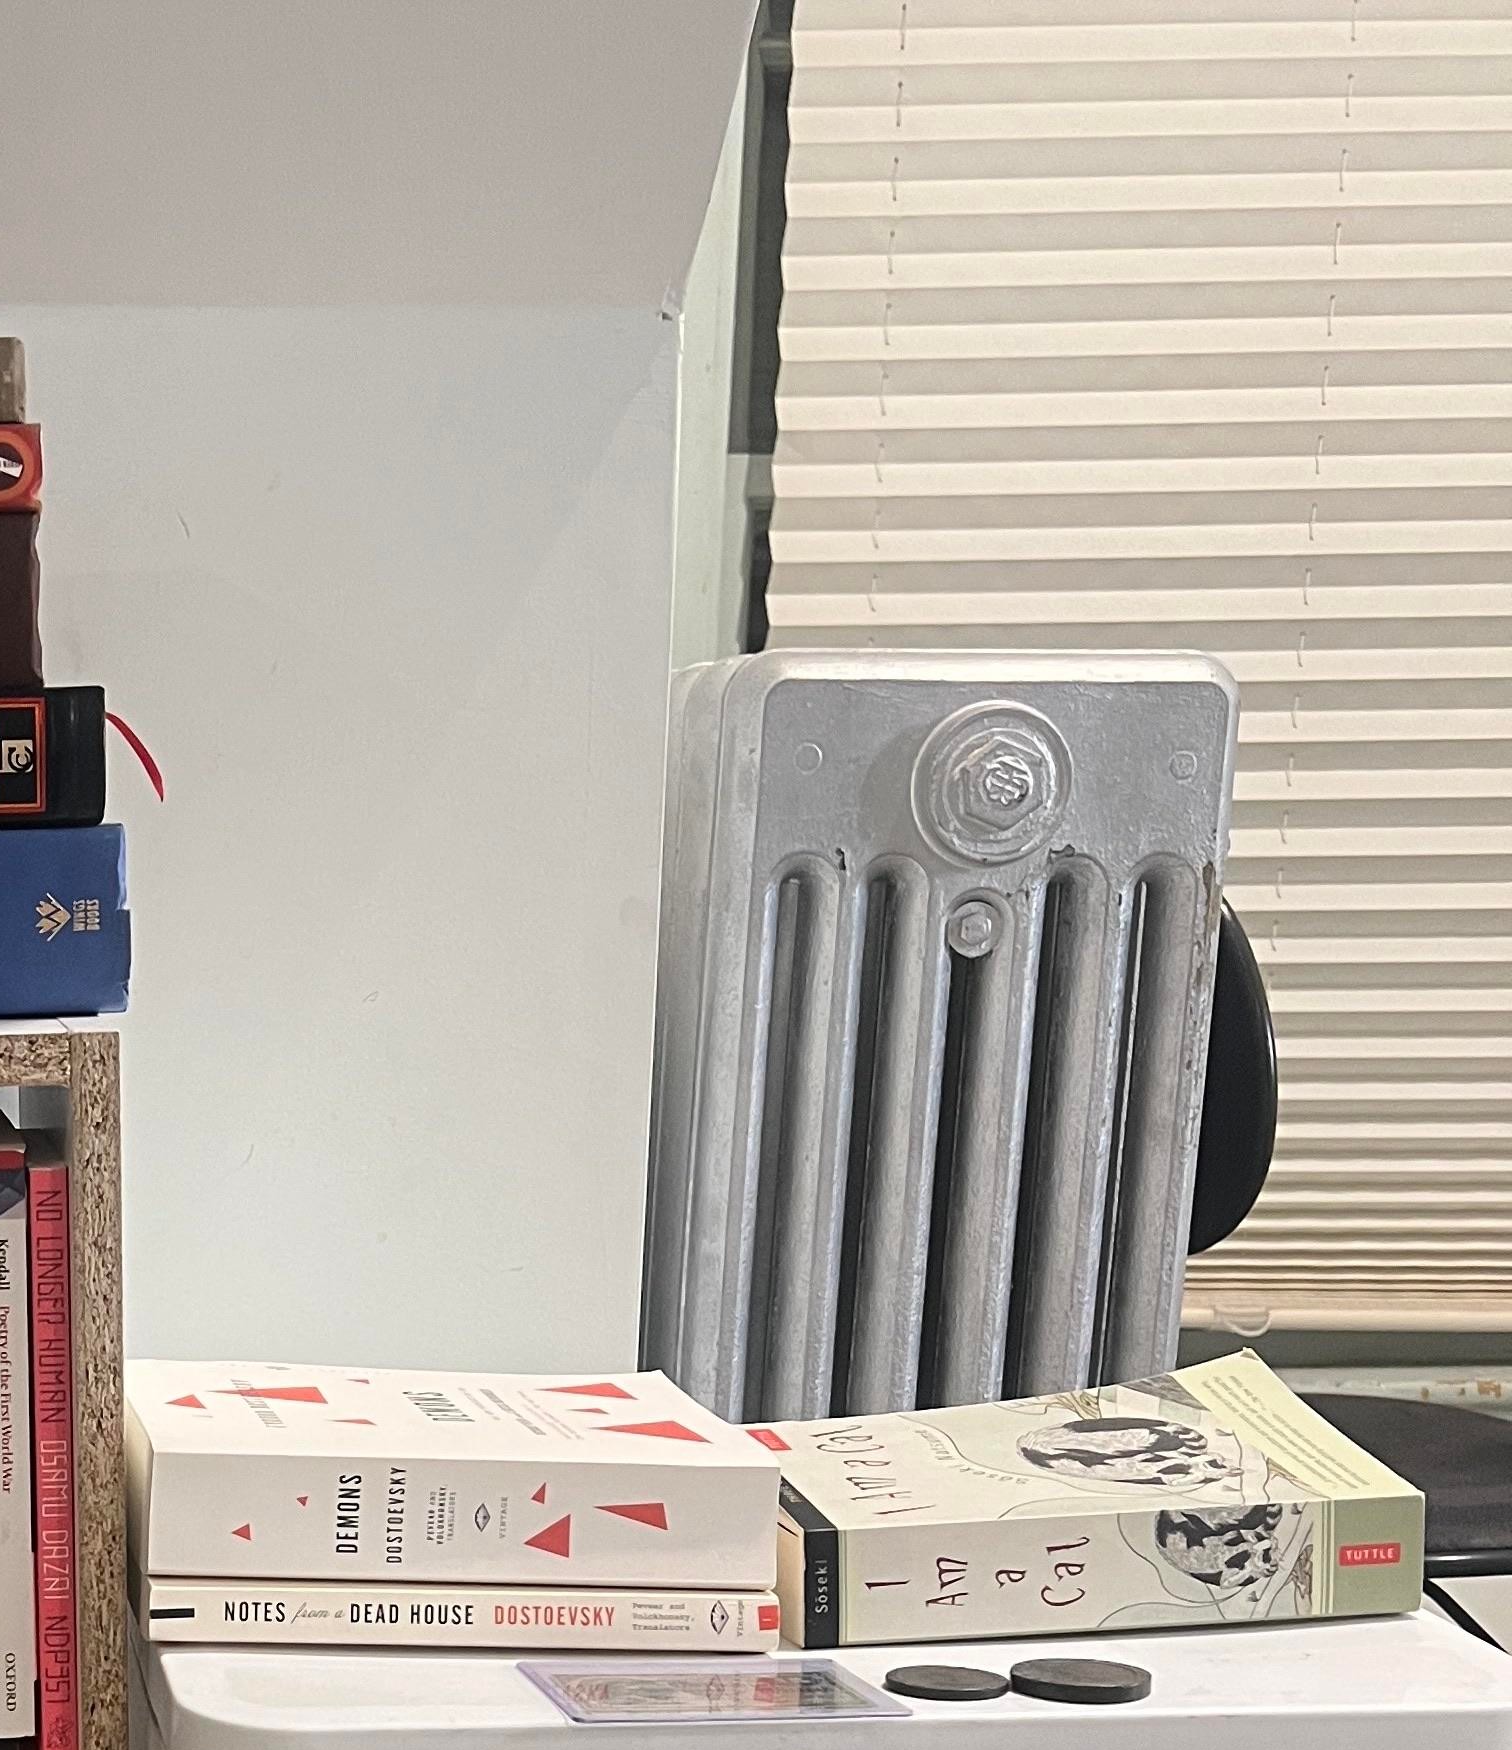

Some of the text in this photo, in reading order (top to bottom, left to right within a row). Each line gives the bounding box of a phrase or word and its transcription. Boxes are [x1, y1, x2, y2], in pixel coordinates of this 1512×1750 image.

[335, 1473, 362, 1554] DEMONS
[386, 1466, 407, 1564] DOSTOEVSKY
[1345, 1546, 1396, 1561] TUTTLE
[224, 1602, 286, 1623] NOTES
[350, 1602, 474, 1626] DEAD HOUSE
[494, 1605, 615, 1628] DOSTOEVSKY
